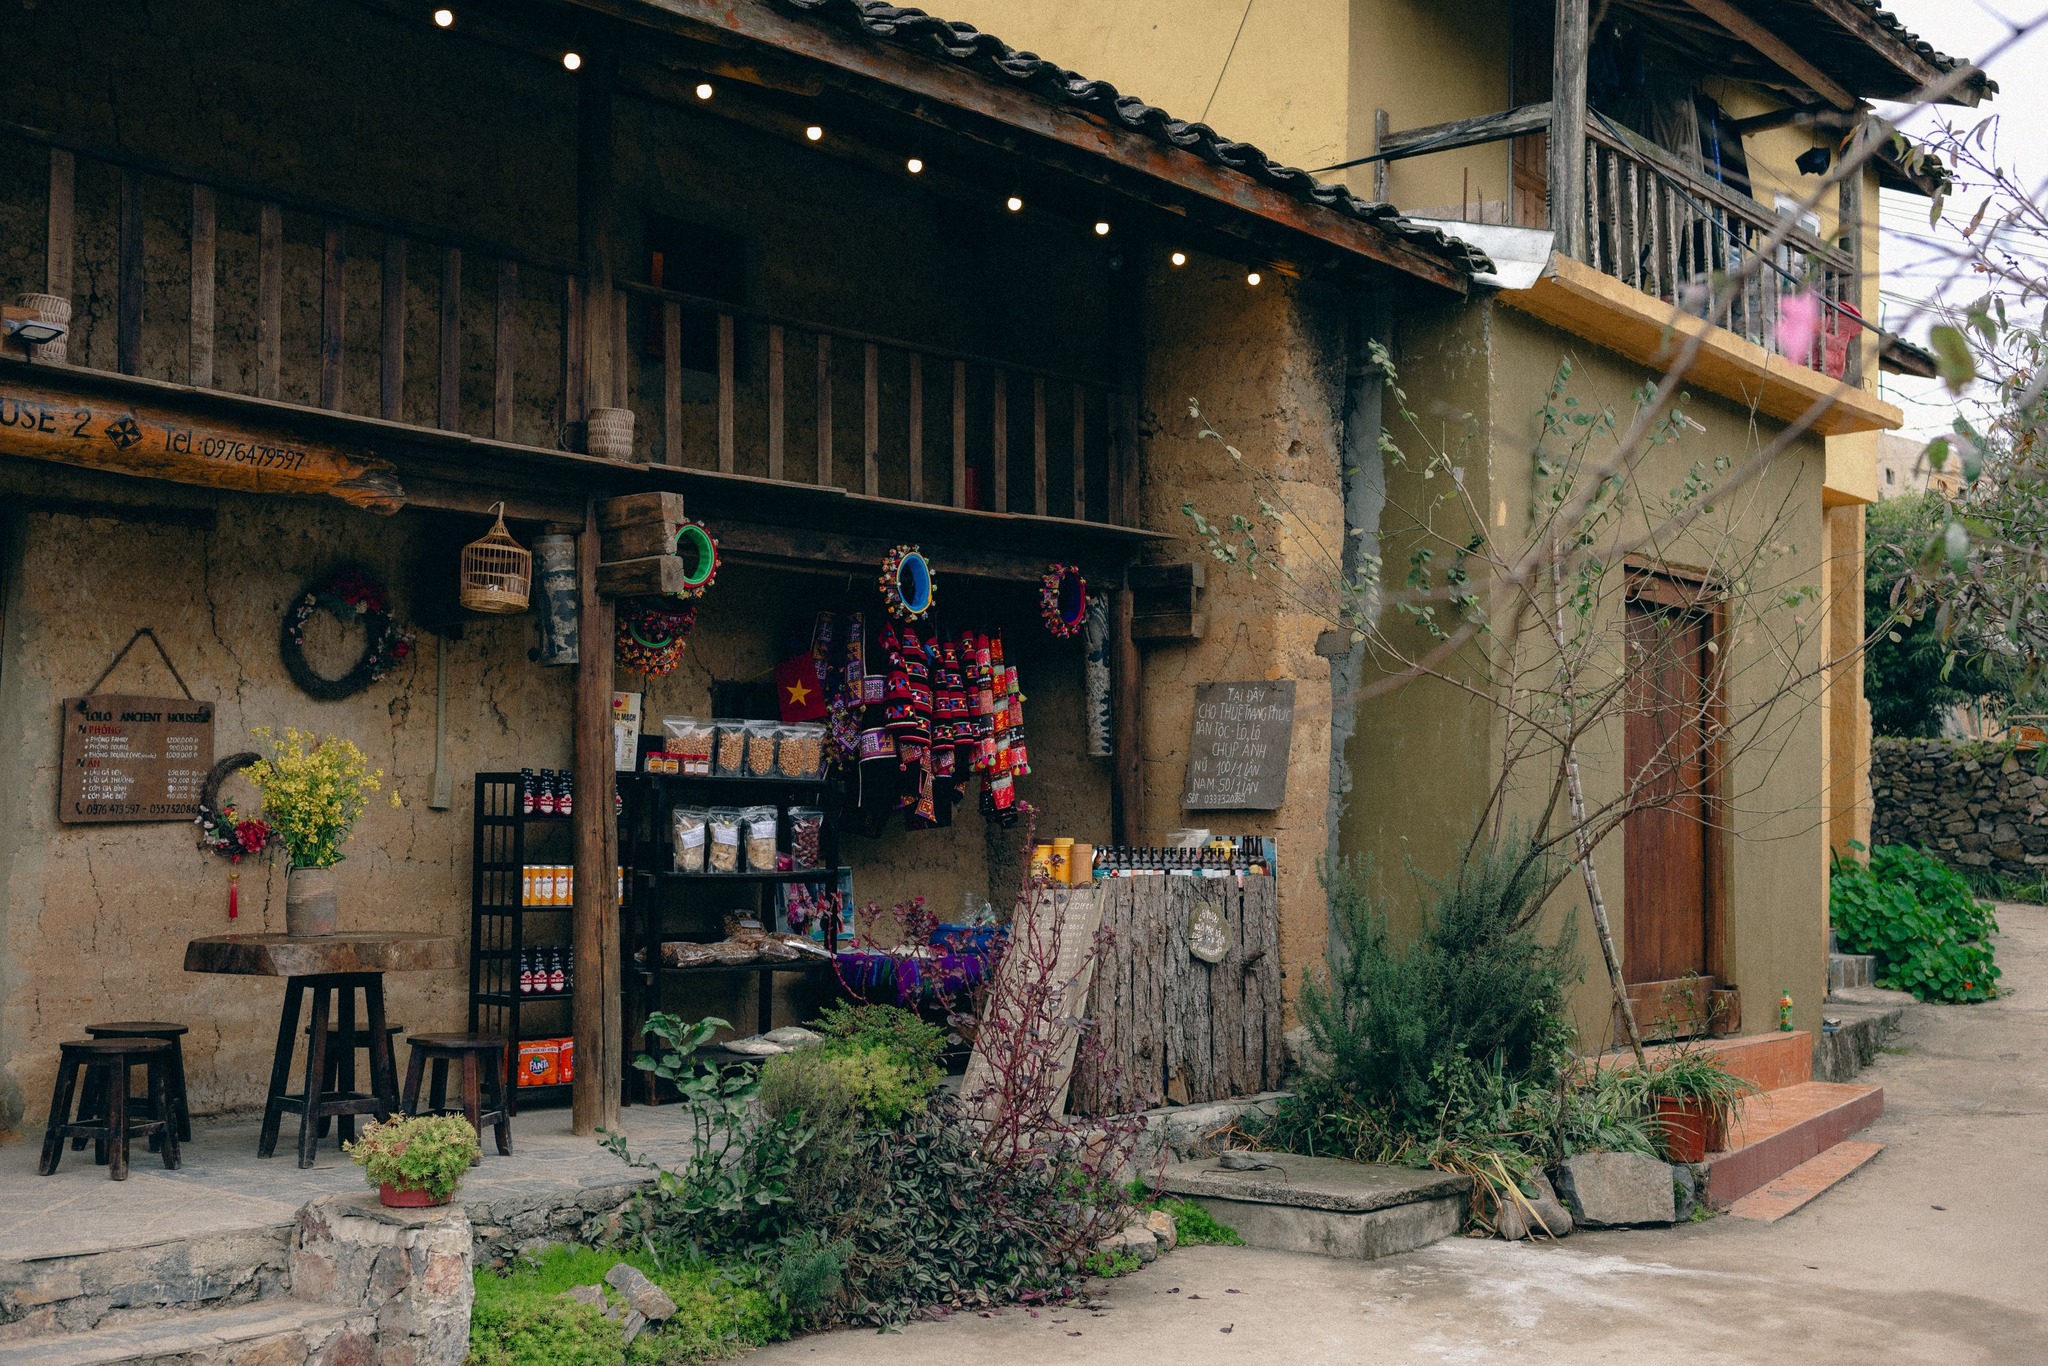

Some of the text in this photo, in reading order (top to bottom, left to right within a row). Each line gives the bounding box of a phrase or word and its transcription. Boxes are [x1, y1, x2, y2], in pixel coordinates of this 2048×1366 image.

[0, 396, 92, 438] USE 2
[162, 425, 192, 454] Tel
[120, 712, 162, 722] ANCIENT
[1198, 703, 1216, 720] CHO
[1196, 720, 1212, 736] DÂN
[1193, 778, 1215, 791] NAM
[530, 1059, 549, 1071] FANTA
